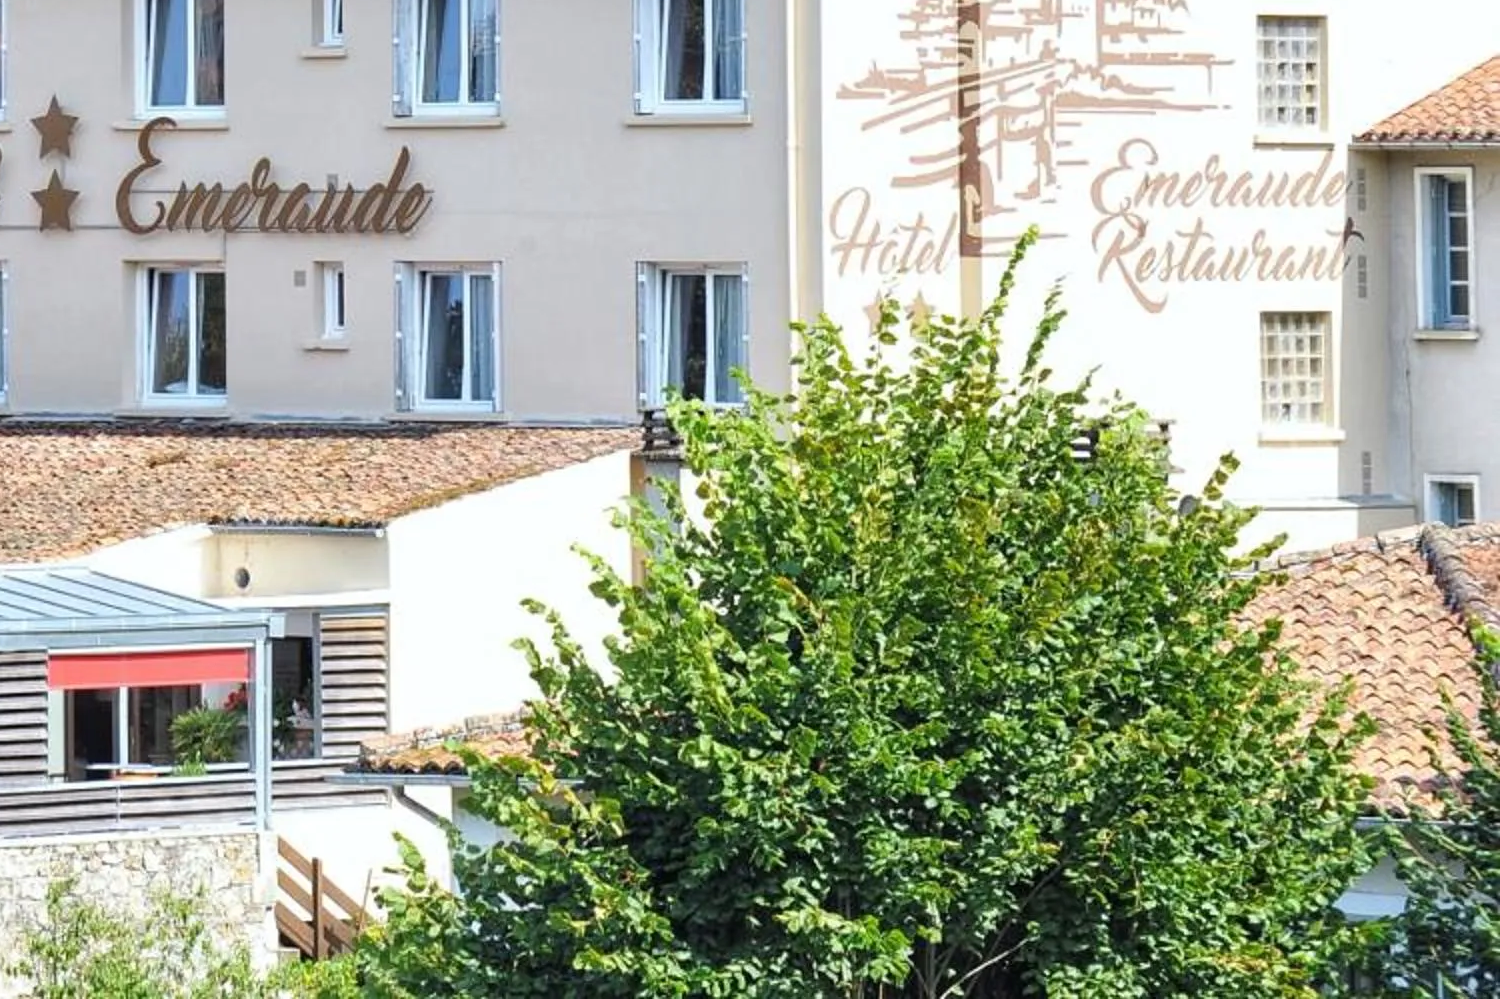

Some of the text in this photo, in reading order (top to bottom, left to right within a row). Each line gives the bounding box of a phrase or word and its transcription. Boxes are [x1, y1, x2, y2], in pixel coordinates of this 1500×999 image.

[115, 116, 433, 236] Emeraude
[1090, 138, 1353, 217] Emeraude
[1091, 212, 1365, 313] Restaurant
